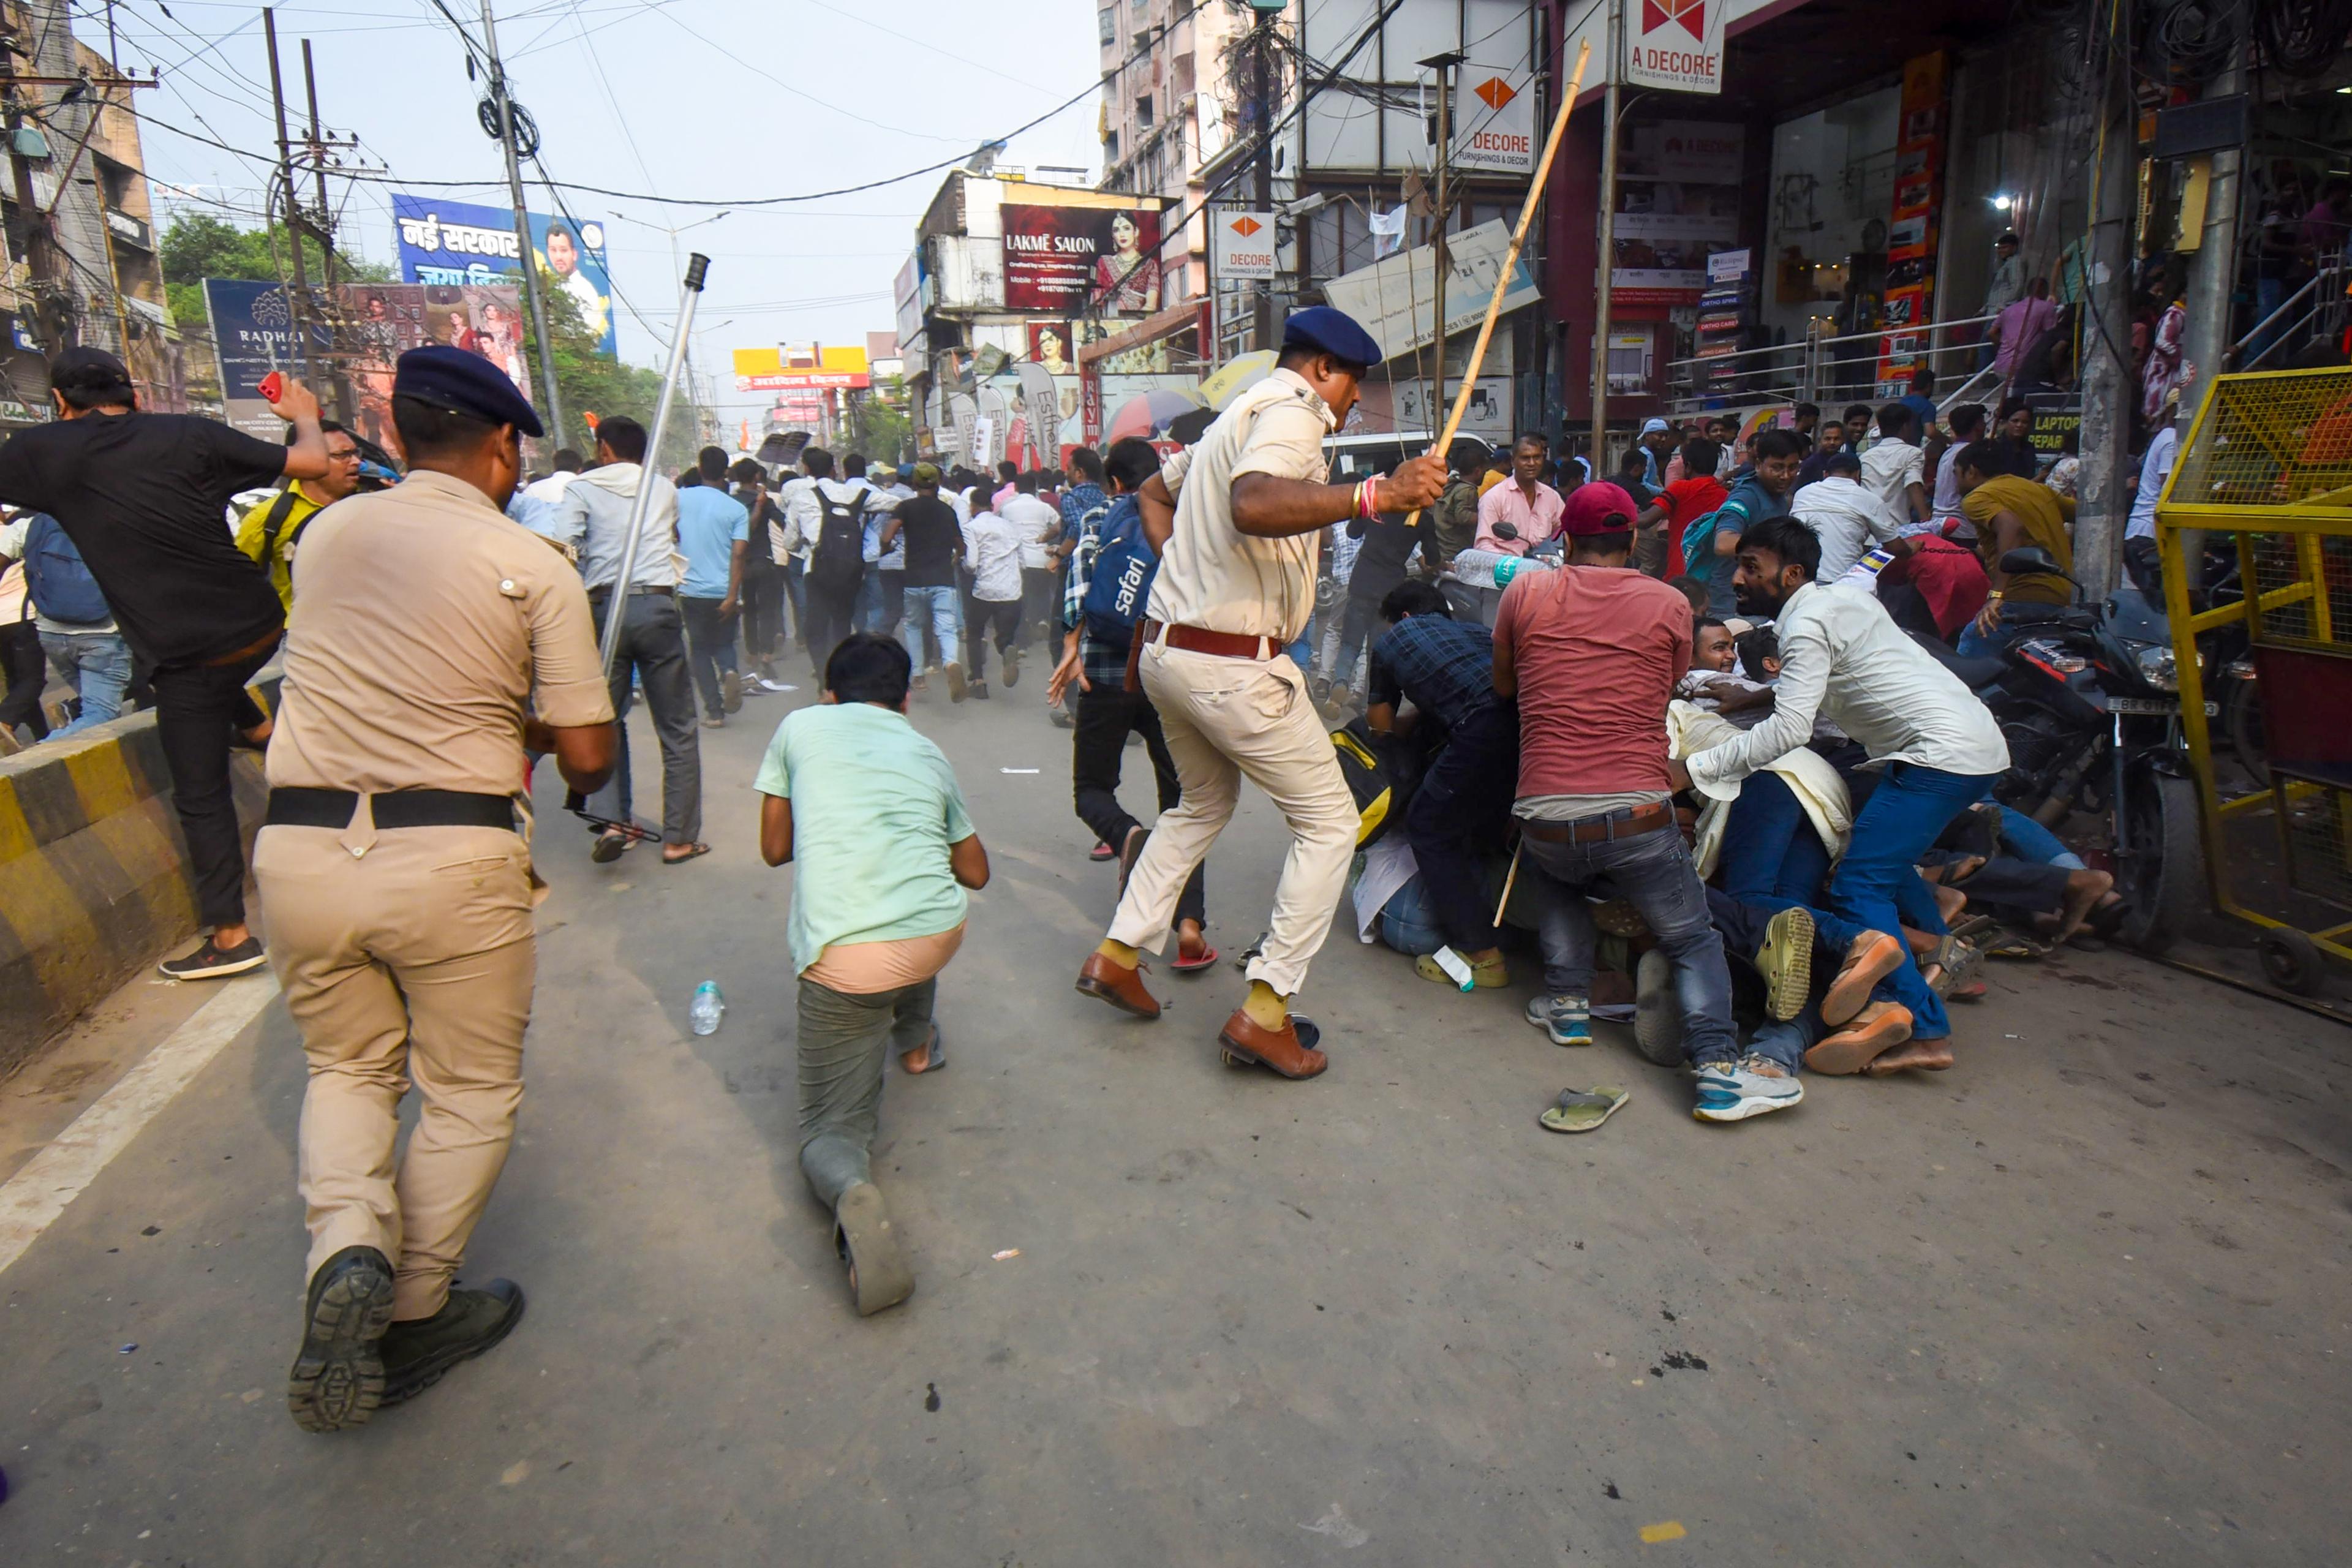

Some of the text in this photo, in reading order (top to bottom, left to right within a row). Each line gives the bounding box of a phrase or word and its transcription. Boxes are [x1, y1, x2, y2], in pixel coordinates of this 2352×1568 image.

[1632, 46, 1715, 77] A DECORE
[1632, 67, 1679, 81] FURNISHINGS
[1689, 76, 1715, 85] DECOR
[1474, 131, 1529, 153] DECORE
[1459, 151, 1500, 163] FURNISHINGS
[1507, 156, 1529, 166] DECOR
[398, 214, 521, 259] नई सरकार
[1054, 236, 1095, 252] SALON
[1231, 254, 1271, 266] DECORE
[1427, 320, 1459, 338] AGCIES
[2035, 416, 2080, 431] LAPTOP
[1115, 555, 1146, 616] safari
[2121, 699, 2138, 710] BR
